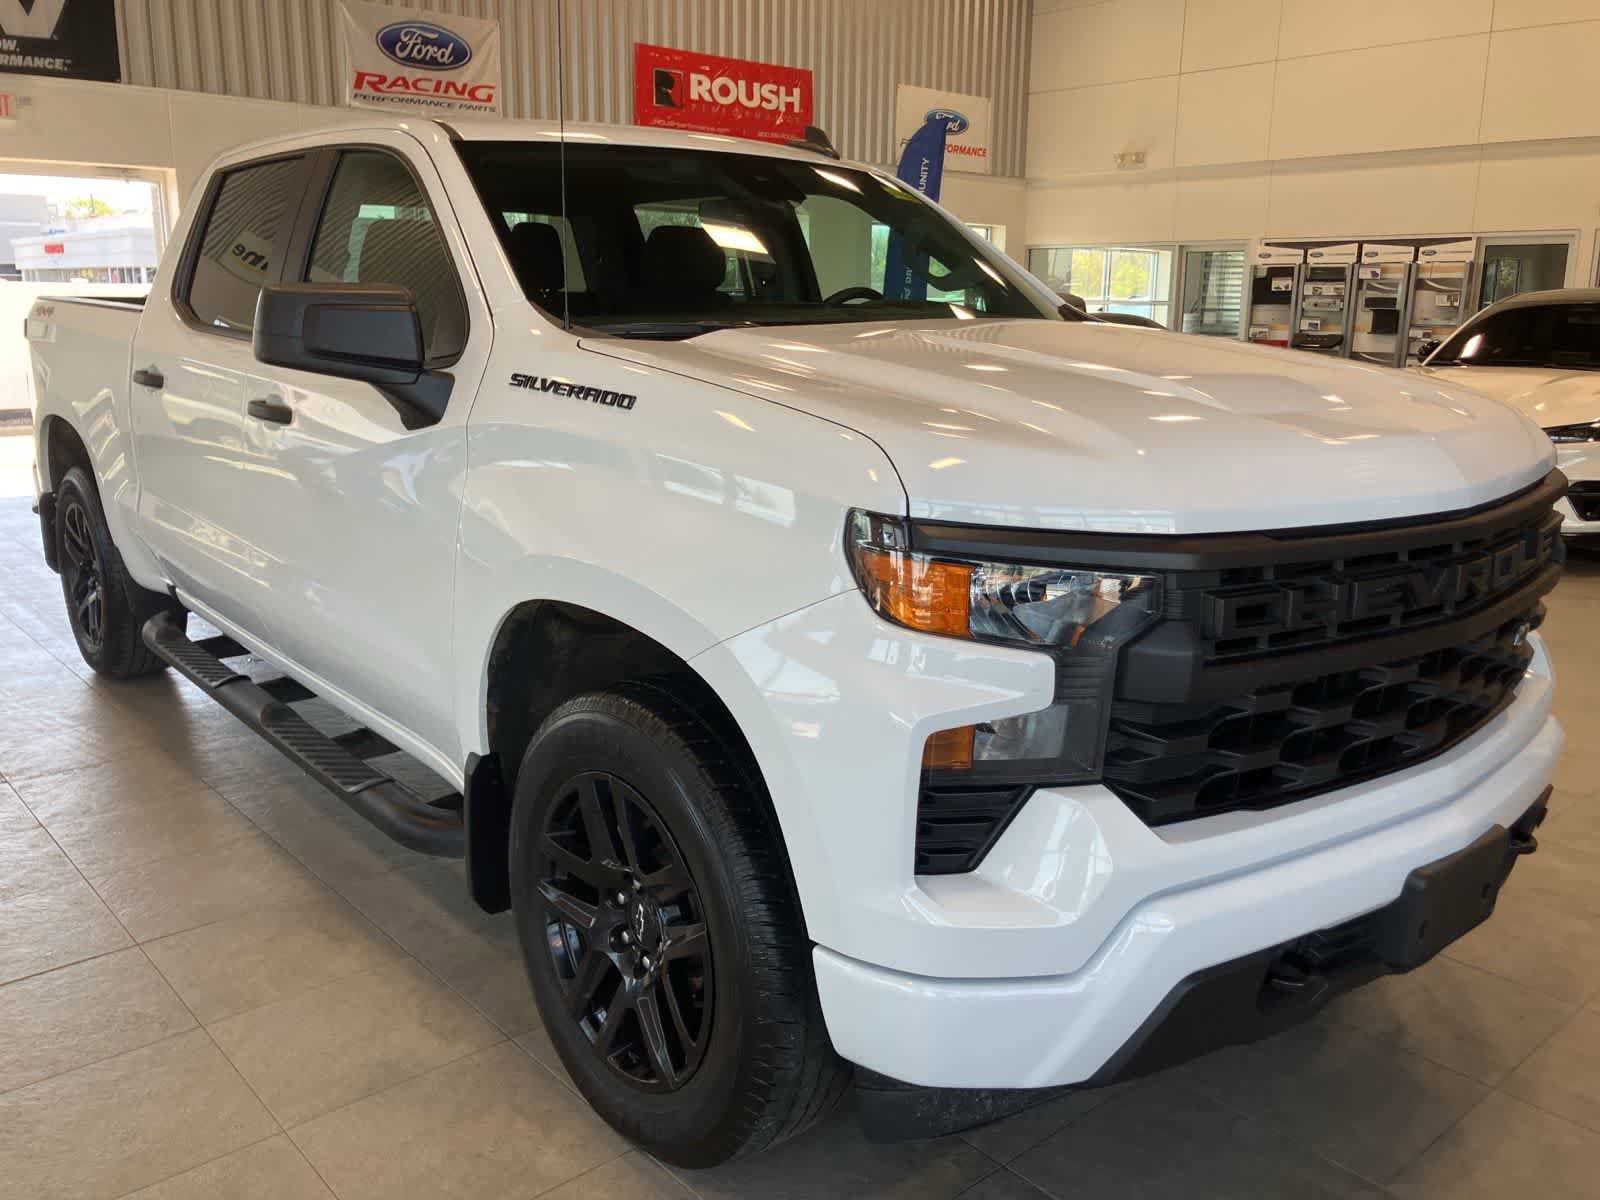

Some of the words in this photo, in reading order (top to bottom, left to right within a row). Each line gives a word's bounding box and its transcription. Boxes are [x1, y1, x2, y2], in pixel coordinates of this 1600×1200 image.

[395, 27, 454, 65] Ford
[353, 71, 497, 104] RACING
[353, 92, 455, 109] PERFORMANCE
[458, 103, 497, 113] PARTS
[689, 72, 801, 112] ROUSH
[509, 373, 638, 411] SILVERADO
